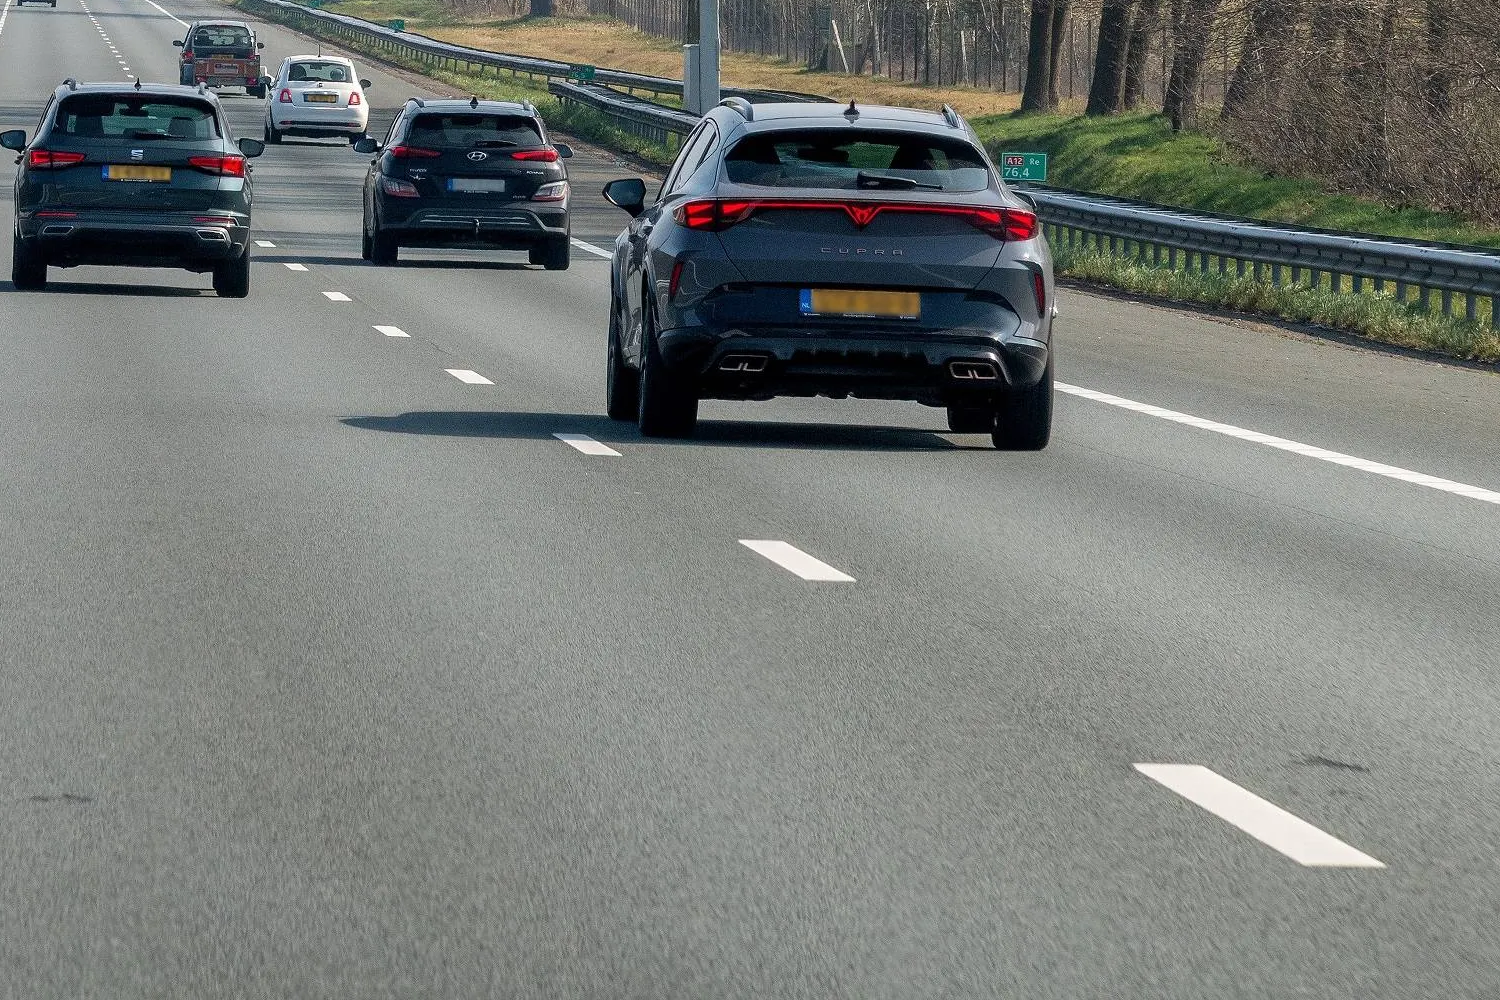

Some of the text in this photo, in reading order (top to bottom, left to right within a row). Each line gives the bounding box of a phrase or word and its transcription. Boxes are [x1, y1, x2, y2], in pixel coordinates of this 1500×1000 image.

[1007, 157, 1040, 166] A12 Re
[1004, 167, 1030, 179] 76,4
[821, 247, 903, 256] CUPRA
